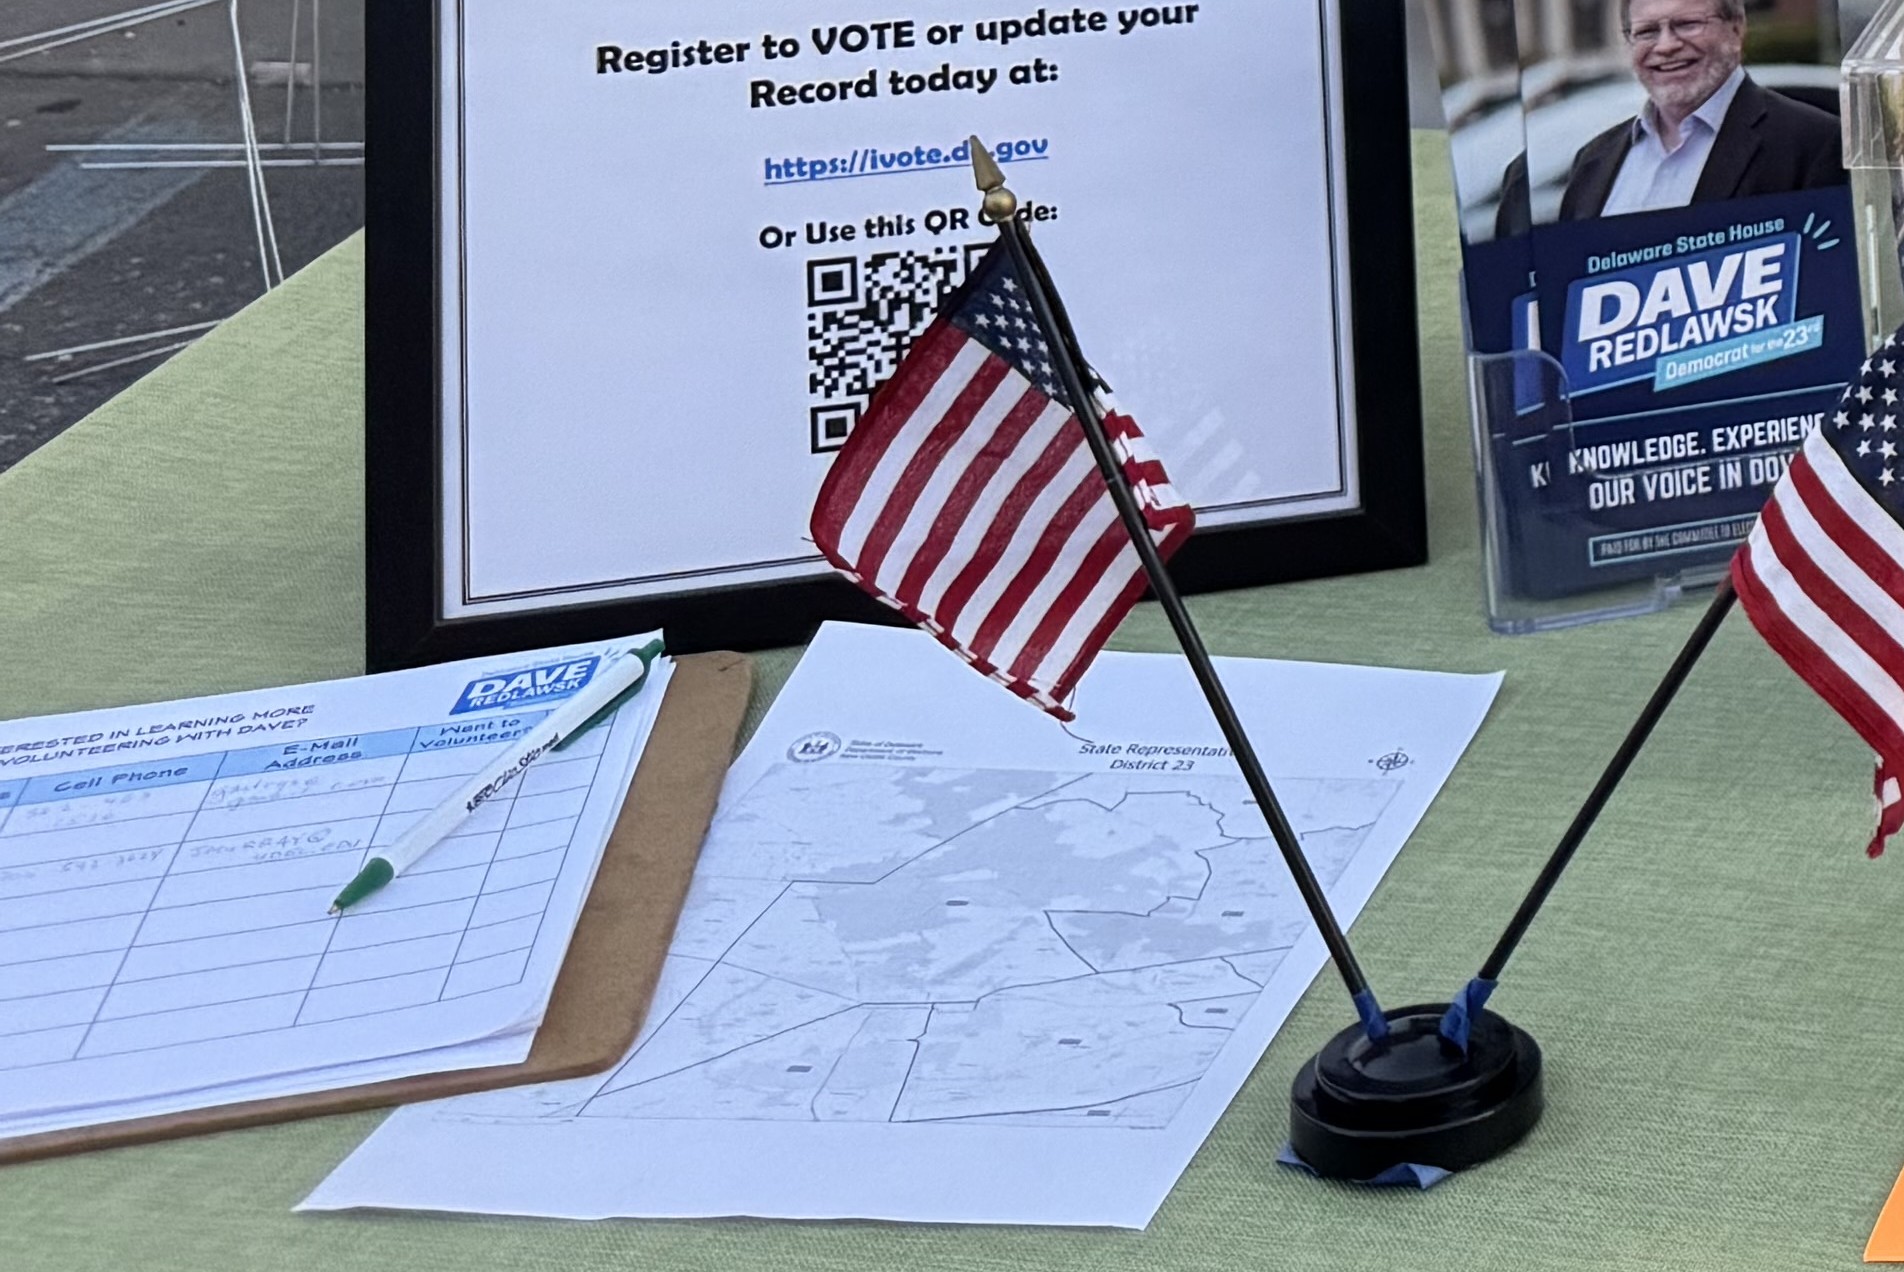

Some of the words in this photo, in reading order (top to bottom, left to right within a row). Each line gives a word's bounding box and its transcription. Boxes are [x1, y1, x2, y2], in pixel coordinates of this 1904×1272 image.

[597, 39, 751, 75] Register
[762, 34, 800, 60] to
[811, 20, 915, 55] VOTE
[927, 23, 963, 45] or
[976, 8, 1108, 46] update
[1118, 3, 1199, 39] your
[750, 70, 878, 108] Record
[889, 62, 997, 96] today
[1009, 59, 1059, 84] at:
[764, 136, 1049, 182] https://ivote.d.gov
[759, 225, 797, 249] Or
[806, 220, 856, 245] Use
[863, 214, 916, 241] this
[924, 208, 970, 237] QR
[1588, 244, 1672, 274] Delaware
[1676, 233, 1725, 253] State
[1729, 218, 1784, 240] House
[1578, 243, 1785, 343] DAVE
[1589, 295, 1780, 372] REDLAWSK
[1666, 344, 1749, 380] Democrat
[467, 660, 592, 699] DAVE
[470, 679, 582, 707] REDLAWSK
[136, 713, 245, 736] LEARNING
[252, 704, 315, 721] MORE
[264, 751, 364, 773] Address
[282, 735, 360, 758] E-Mail
[1079, 742, 1122, 756] State
[1110, 759, 1168, 771] District
[1172, 759, 1195, 771] 23
[54, 777, 101, 793] Cell
[112, 767, 189, 785] Phone
